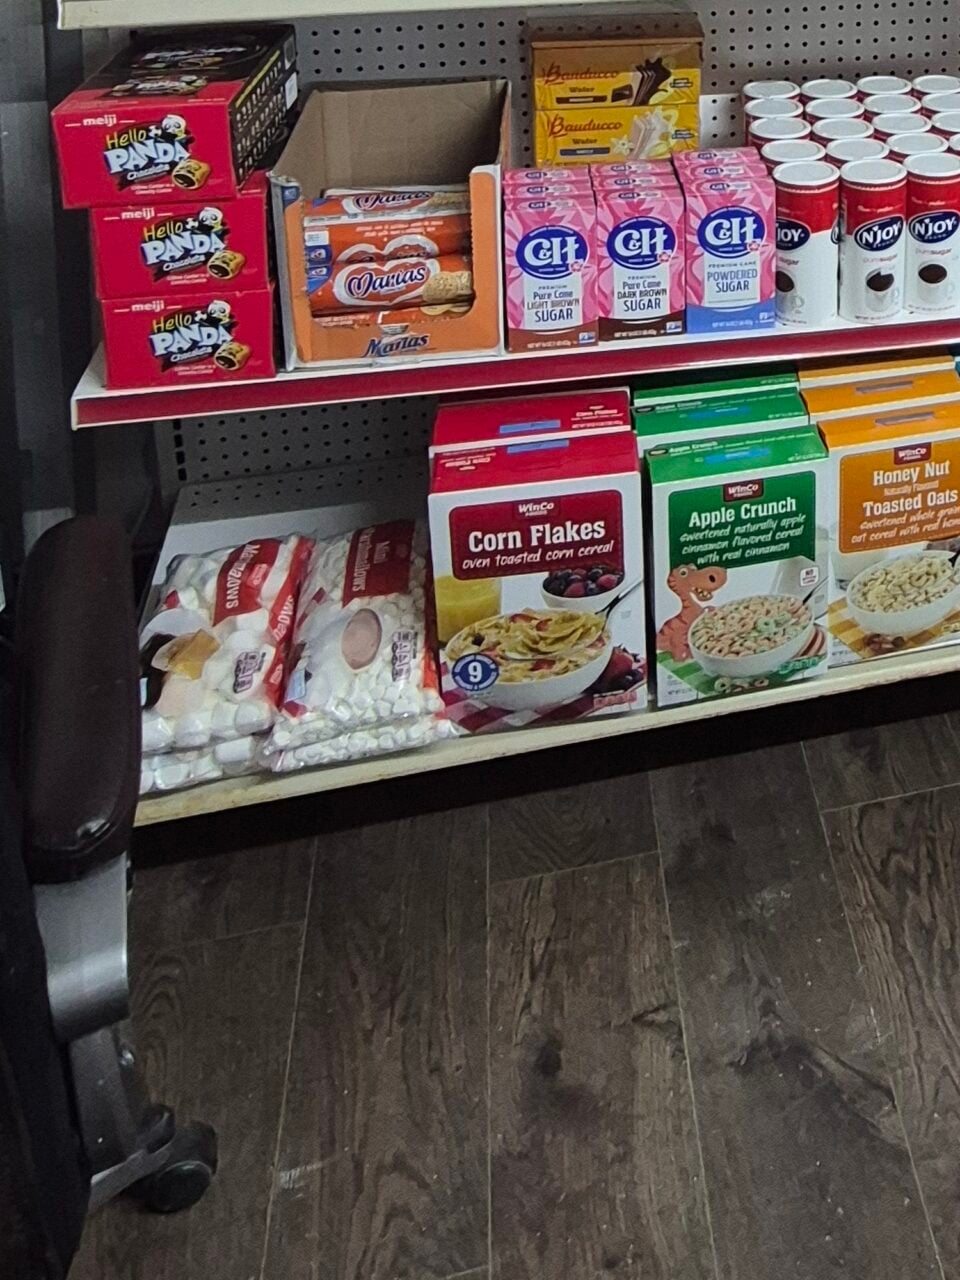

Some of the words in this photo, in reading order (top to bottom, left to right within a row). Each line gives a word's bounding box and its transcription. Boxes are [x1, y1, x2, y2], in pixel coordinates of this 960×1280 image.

[542, 62, 620, 86] Bauducco
[83, 114, 117, 127] meiji
[547, 113, 623, 138] Bauducco
[105, 127, 147, 149] Hello
[104, 139, 190, 174] PANDA
[121, 207, 155, 221] meiji
[143, 221, 183, 243] Hello
[705, 216, 758, 246] C&H
[142, 231, 228, 266] PANDA
[523, 235, 580, 267] C&H
[614, 227, 669, 258] C&H
[622, 281, 640, 291] Pure
[707, 268, 758, 282] POWDERED
[533, 290, 552, 300] Pure
[617, 288, 638, 300] DARK
[639, 287, 668, 299] BROWN
[716, 281, 750, 296] SUGAR
[131, 300, 165, 313] meiji
[527, 298, 549, 310] LIGHT
[550, 297, 580, 308] BROWN
[623, 297, 661, 313] SUGAR
[152, 314, 192, 334] Hello
[534, 307, 574, 323] SUGAR
[150, 324, 236, 357] PANDA
[872, 466, 921, 487] Honey
[924, 459, 951, 478] Nut
[728, 483, 760, 496] WinCo
[518, 501, 555, 514] WinCo
[688, 506, 736, 530] Apple
[740, 496, 797, 521] Crunch
[862, 494, 923, 517] Toasted
[927, 488, 959, 507] Oats
[909, 508, 935, 523] whole
[468, 529, 523, 554] Corn
[529, 520, 607, 548] Flakes
[680, 524, 732, 543] sweetened
[734, 516, 778, 535] naturally
[780, 513, 807, 528] apple
[775, 526, 804, 541] cereal
[869, 526, 897, 541] cereal
[899, 521, 921, 537] with
[922, 518, 941, 533] real
[462, 556, 491, 570] oven
[495, 548, 542, 567] toasted
[545, 548, 574, 562] corn
[577, 540, 614, 558] cereal
[697, 550, 720, 565] with
[723, 546, 742, 561] real
[467, 660, 483, 684] 9
